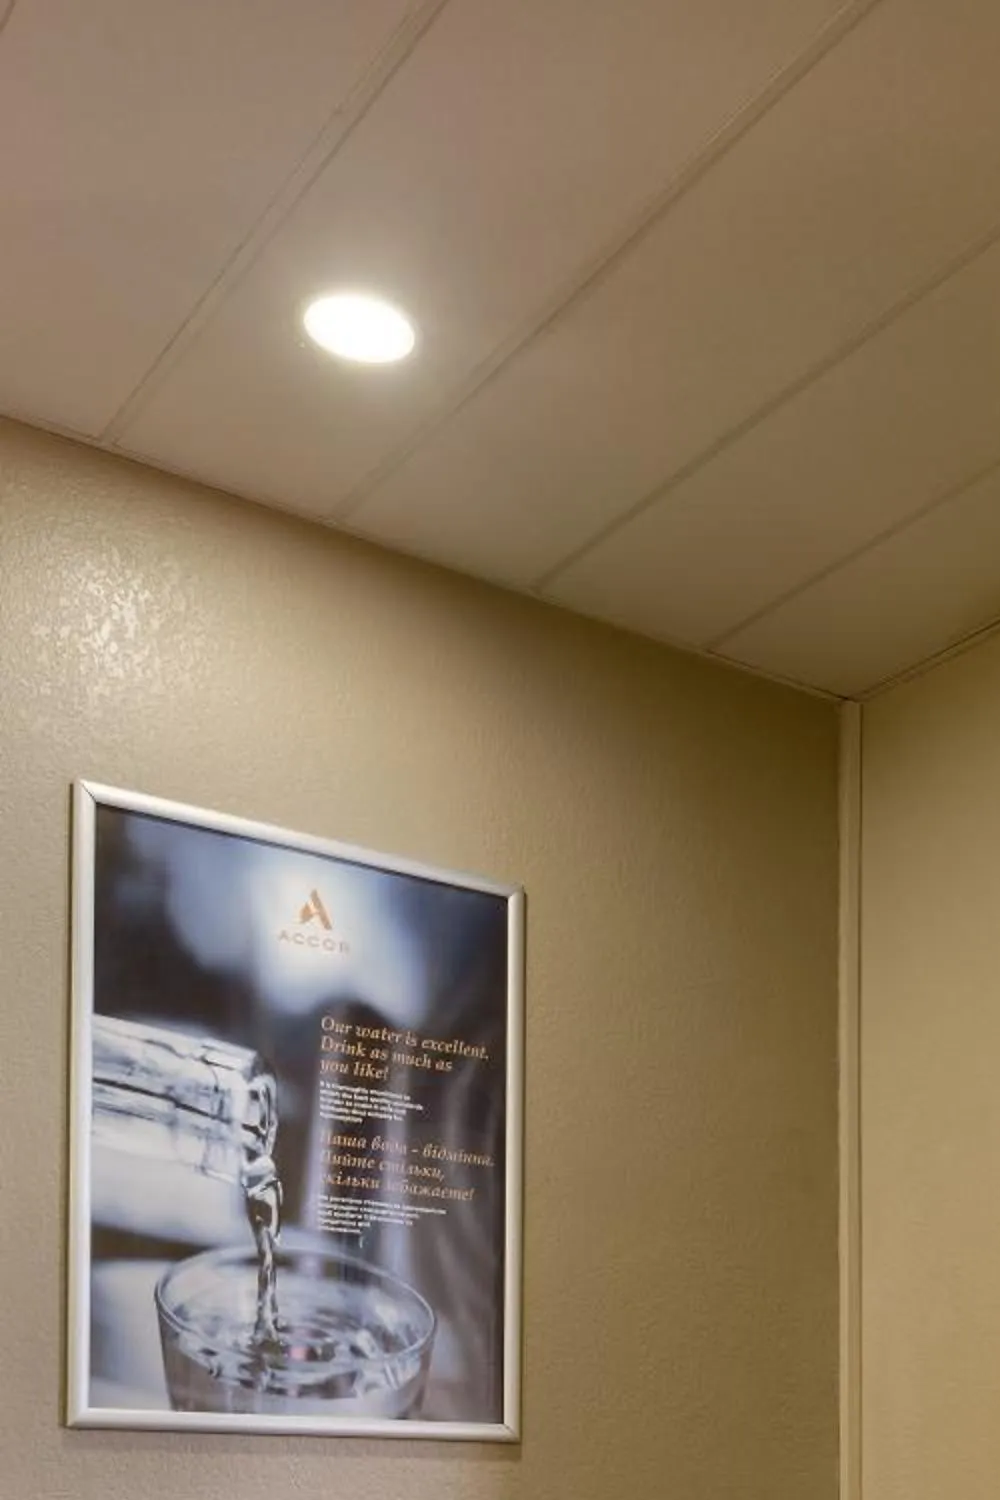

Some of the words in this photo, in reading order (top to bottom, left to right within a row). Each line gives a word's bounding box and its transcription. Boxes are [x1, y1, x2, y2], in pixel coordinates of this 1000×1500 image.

[278, 929, 350, 954] ACCOR
[321, 1016, 353, 1034] Our
[355, 1025, 402, 1043] water
[405, 1031, 417, 1047] is
[421, 1039, 489, 1060] excellent.
[321, 1035, 367, 1057] Drink
[369, 1047, 387, 1061] as
[392, 1050, 432, 1069] much
[435, 1060, 453, 1073] as
[320, 1059, 349, 1075] you
[353, 1061, 390, 1081] like!
